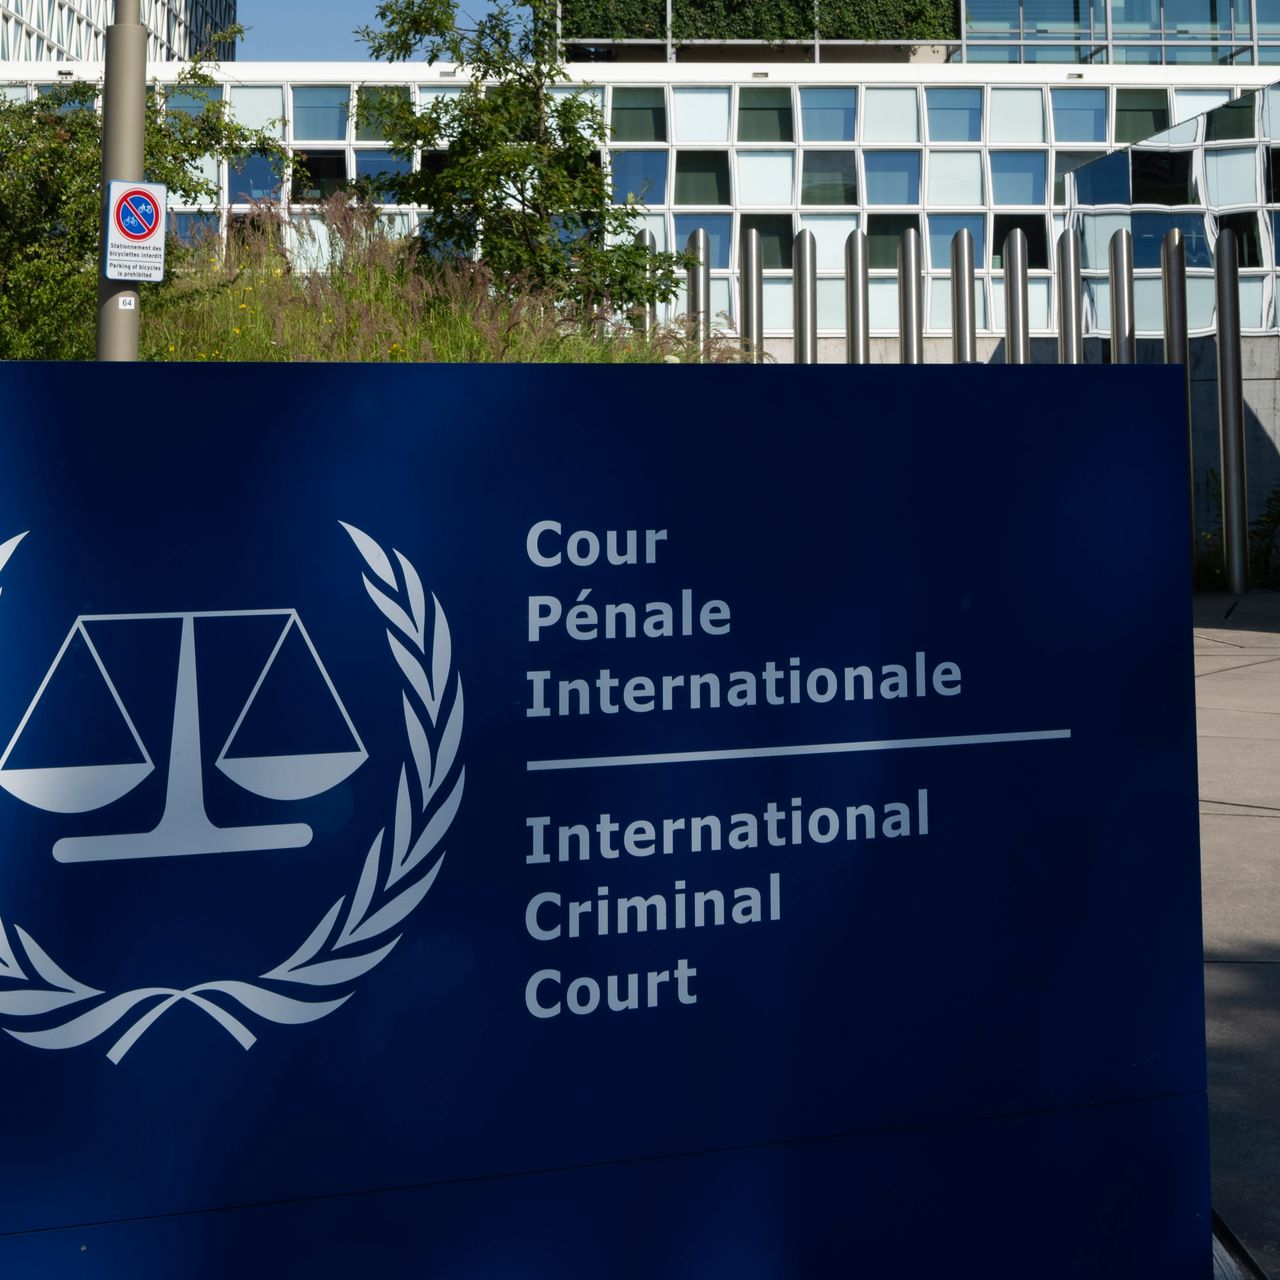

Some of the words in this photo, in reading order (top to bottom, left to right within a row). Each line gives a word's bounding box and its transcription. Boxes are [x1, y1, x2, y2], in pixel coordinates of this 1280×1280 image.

[109, 250, 140, 258] bicyclettes
[109, 262, 131, 271] Parking
[110, 243, 151, 251] Stationnement
[122, 299, 132, 307] 64
[526, 519, 668, 568] Cour
[528, 588, 731, 642] Pénale
[526, 652, 962, 718] Internationale
[525, 788, 929, 865] International
[525, 872, 781, 941] Criminal
[525, 958, 697, 1019] Court
